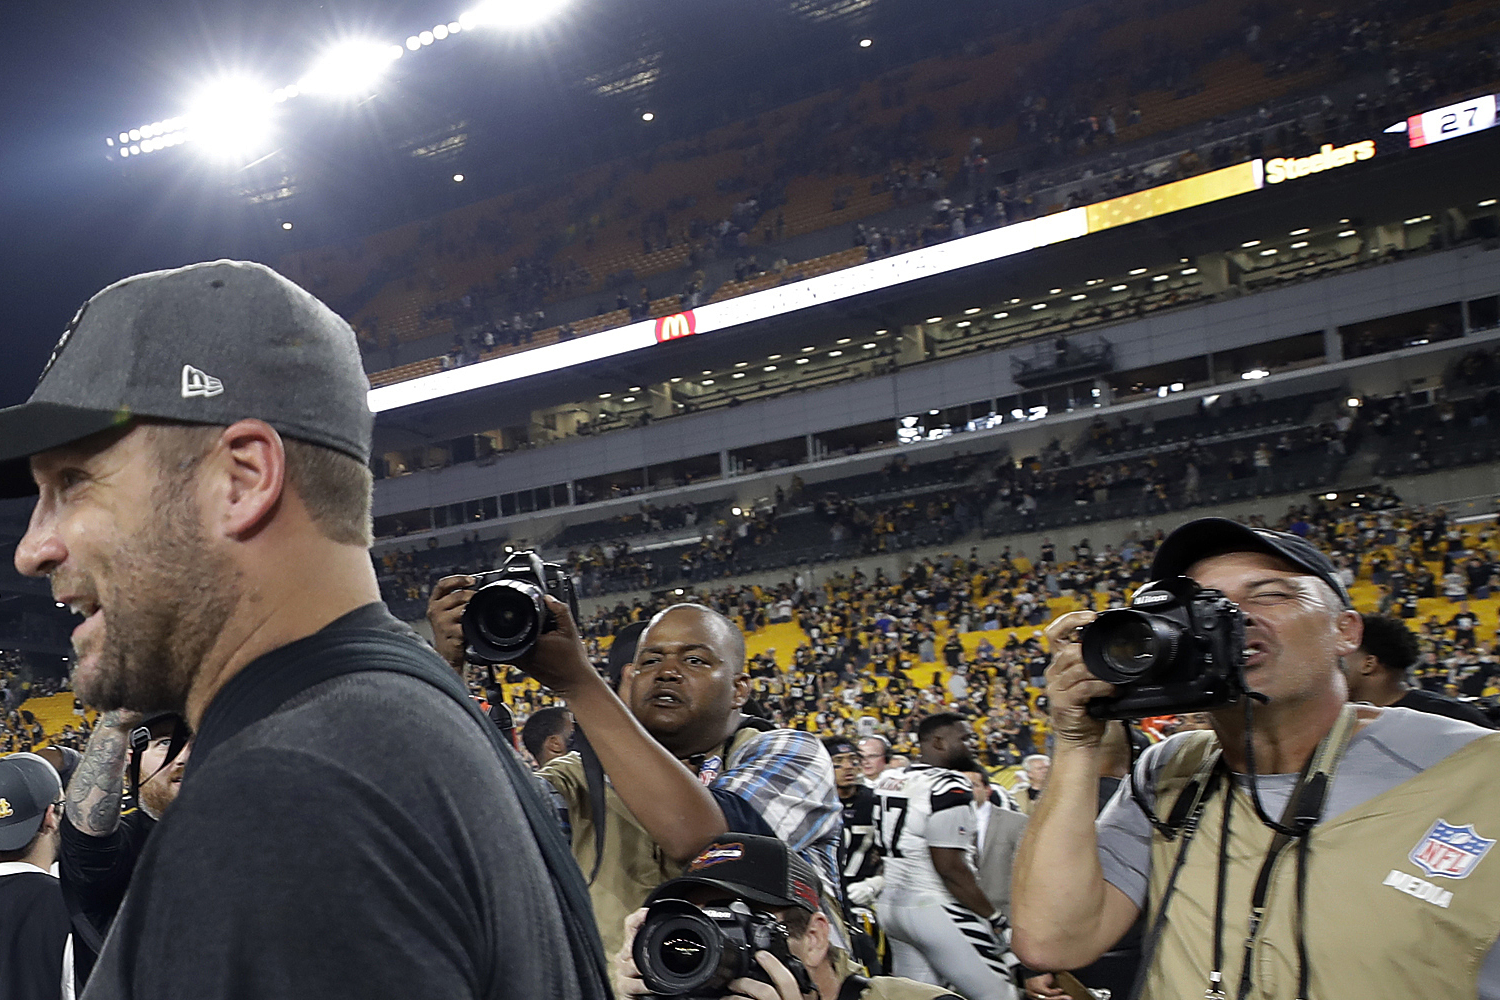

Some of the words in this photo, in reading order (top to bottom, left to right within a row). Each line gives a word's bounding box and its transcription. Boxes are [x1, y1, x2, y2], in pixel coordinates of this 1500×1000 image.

[1439, 106, 1478, 135] 27
[1264, 139, 1376, 184] Steelers
[1415, 841, 1467, 873] NFL
